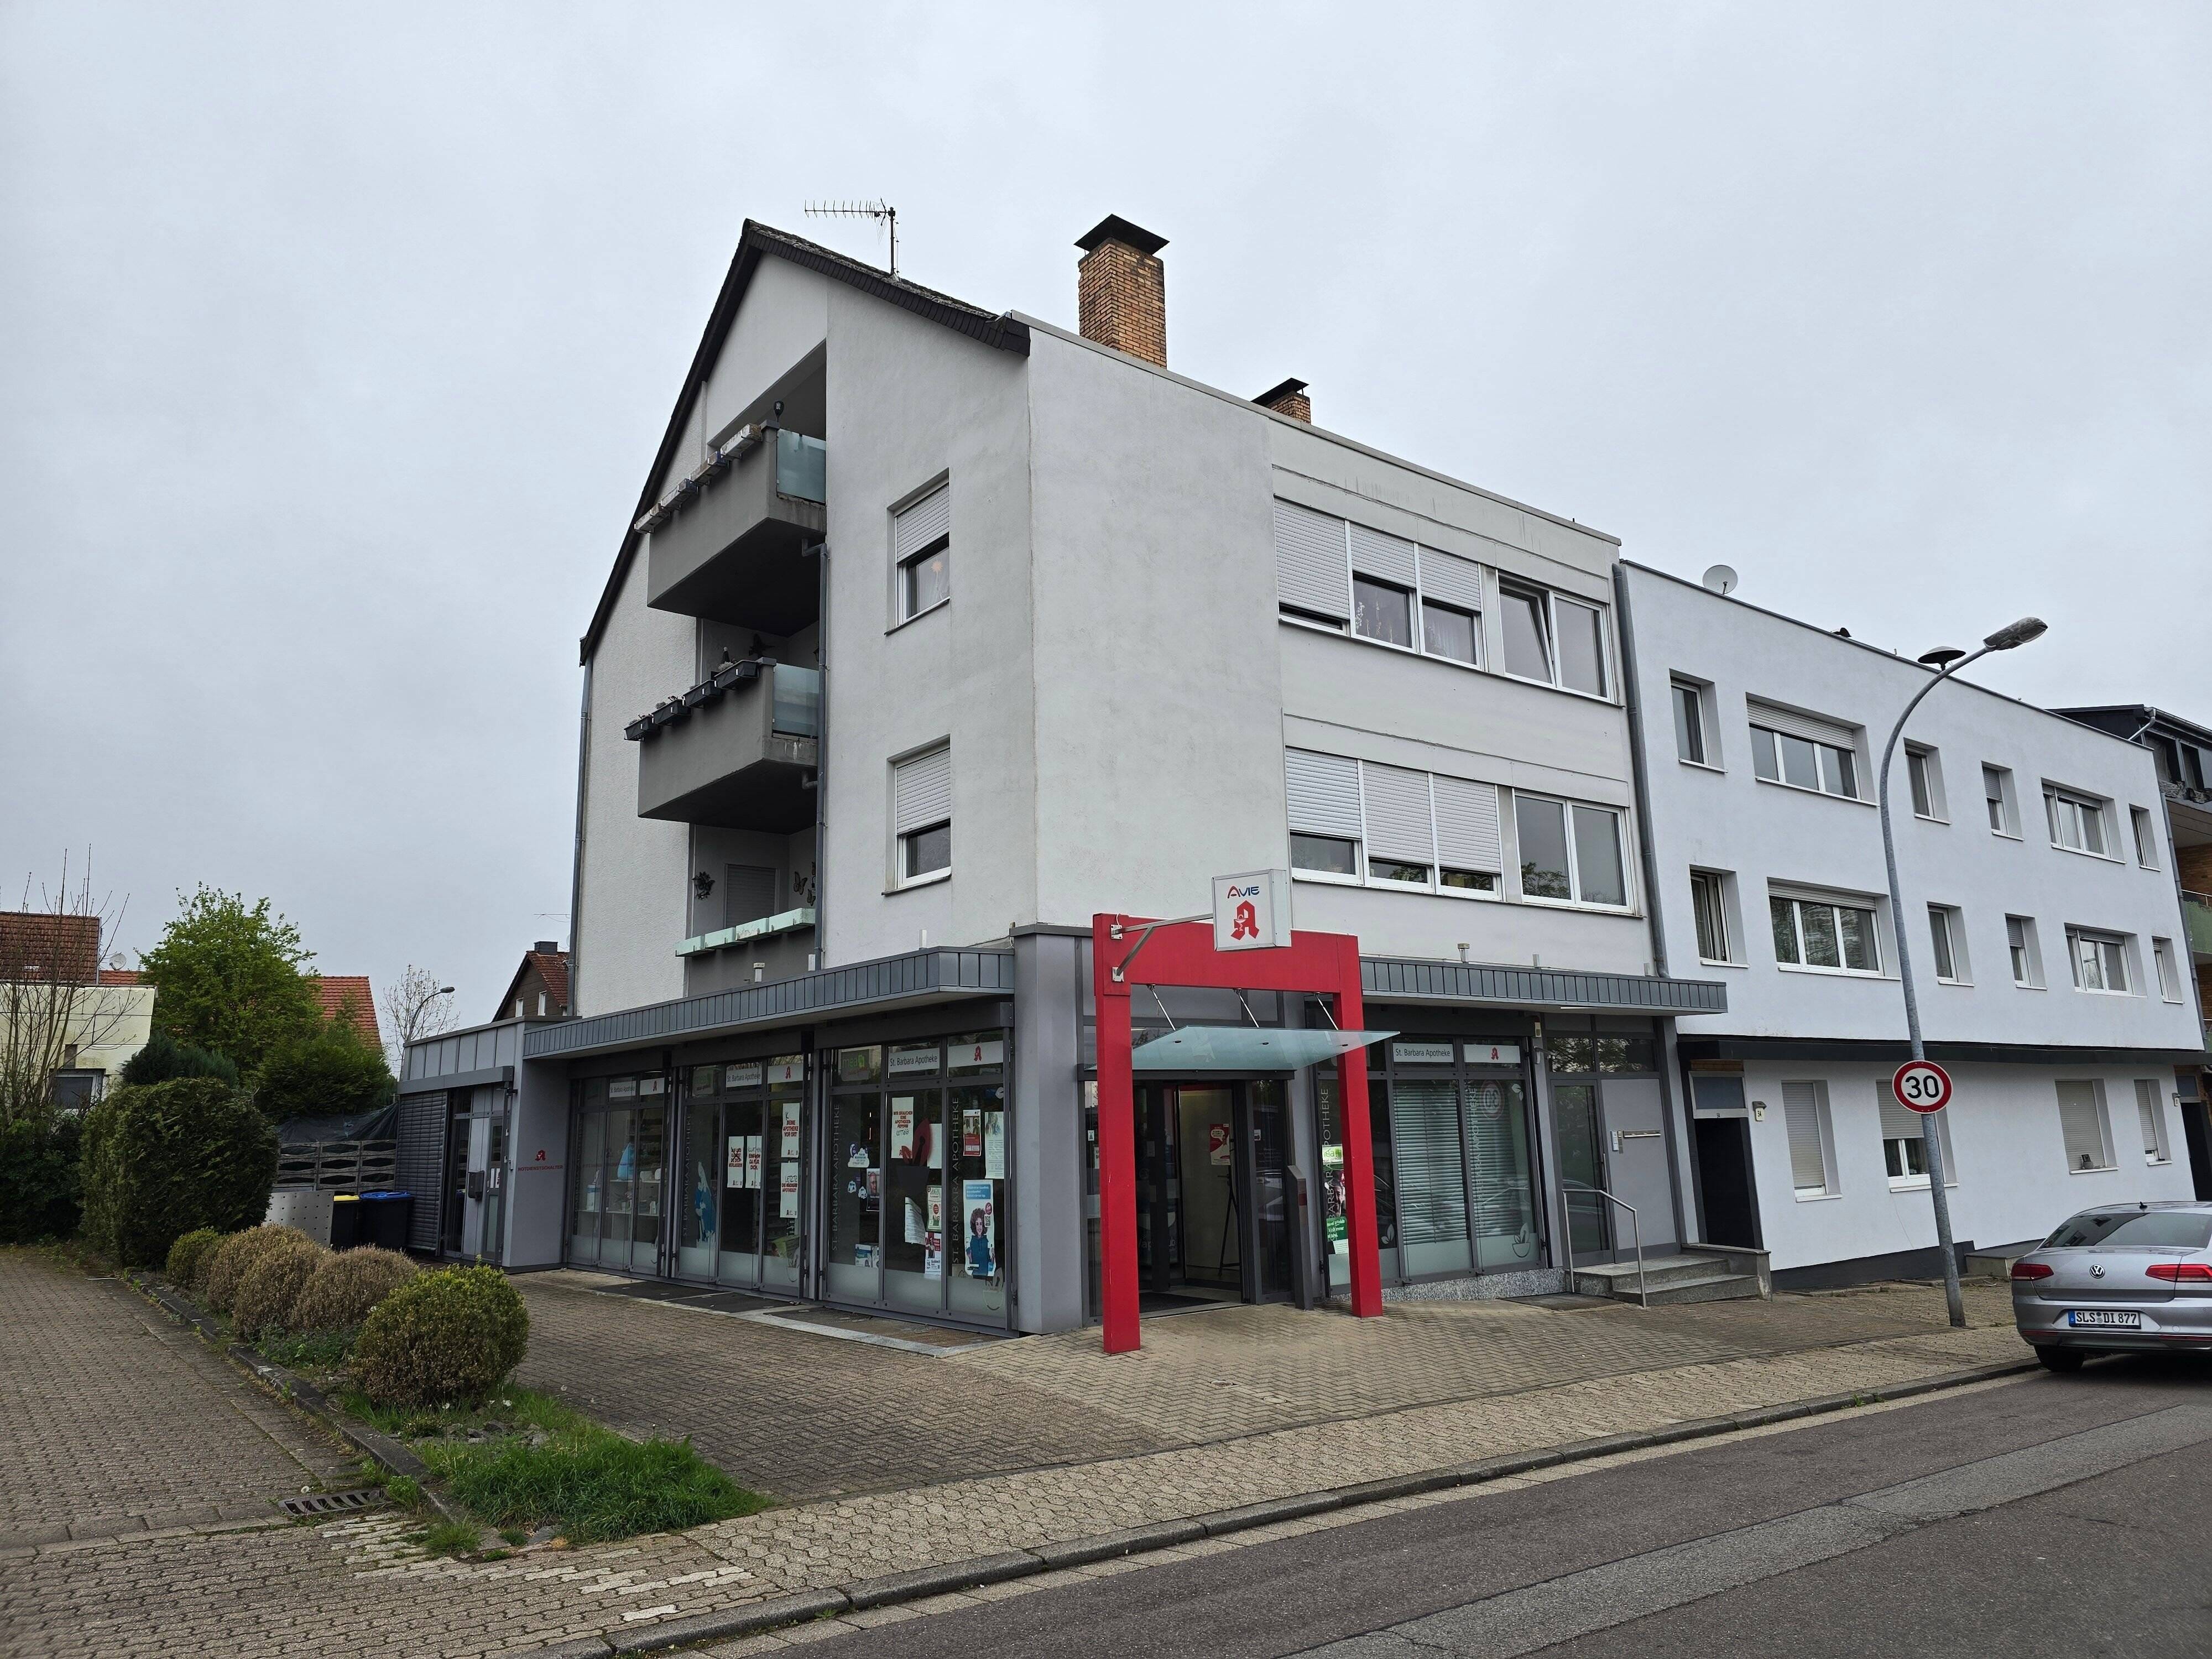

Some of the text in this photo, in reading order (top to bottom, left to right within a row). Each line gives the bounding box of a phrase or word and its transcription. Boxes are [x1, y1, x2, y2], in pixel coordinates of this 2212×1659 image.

[1404, 1048, 1425, 1057] Barbara
[1426, 1049, 1451, 1057] Apotheke
[896, 1056, 914, 1066] Barbara
[915, 1053, 937, 1064] Apotheke
[623, 1084, 635, 1093] Apotheke
[1905, 1075, 1939, 1099] 30
[1326, 1160, 1335, 1218] BARBARA
[2076, 1312, 2095, 1322] SLS
[2104, 1313, 2115, 1323] DI
[2118, 1313, 2137, 1324] 877
